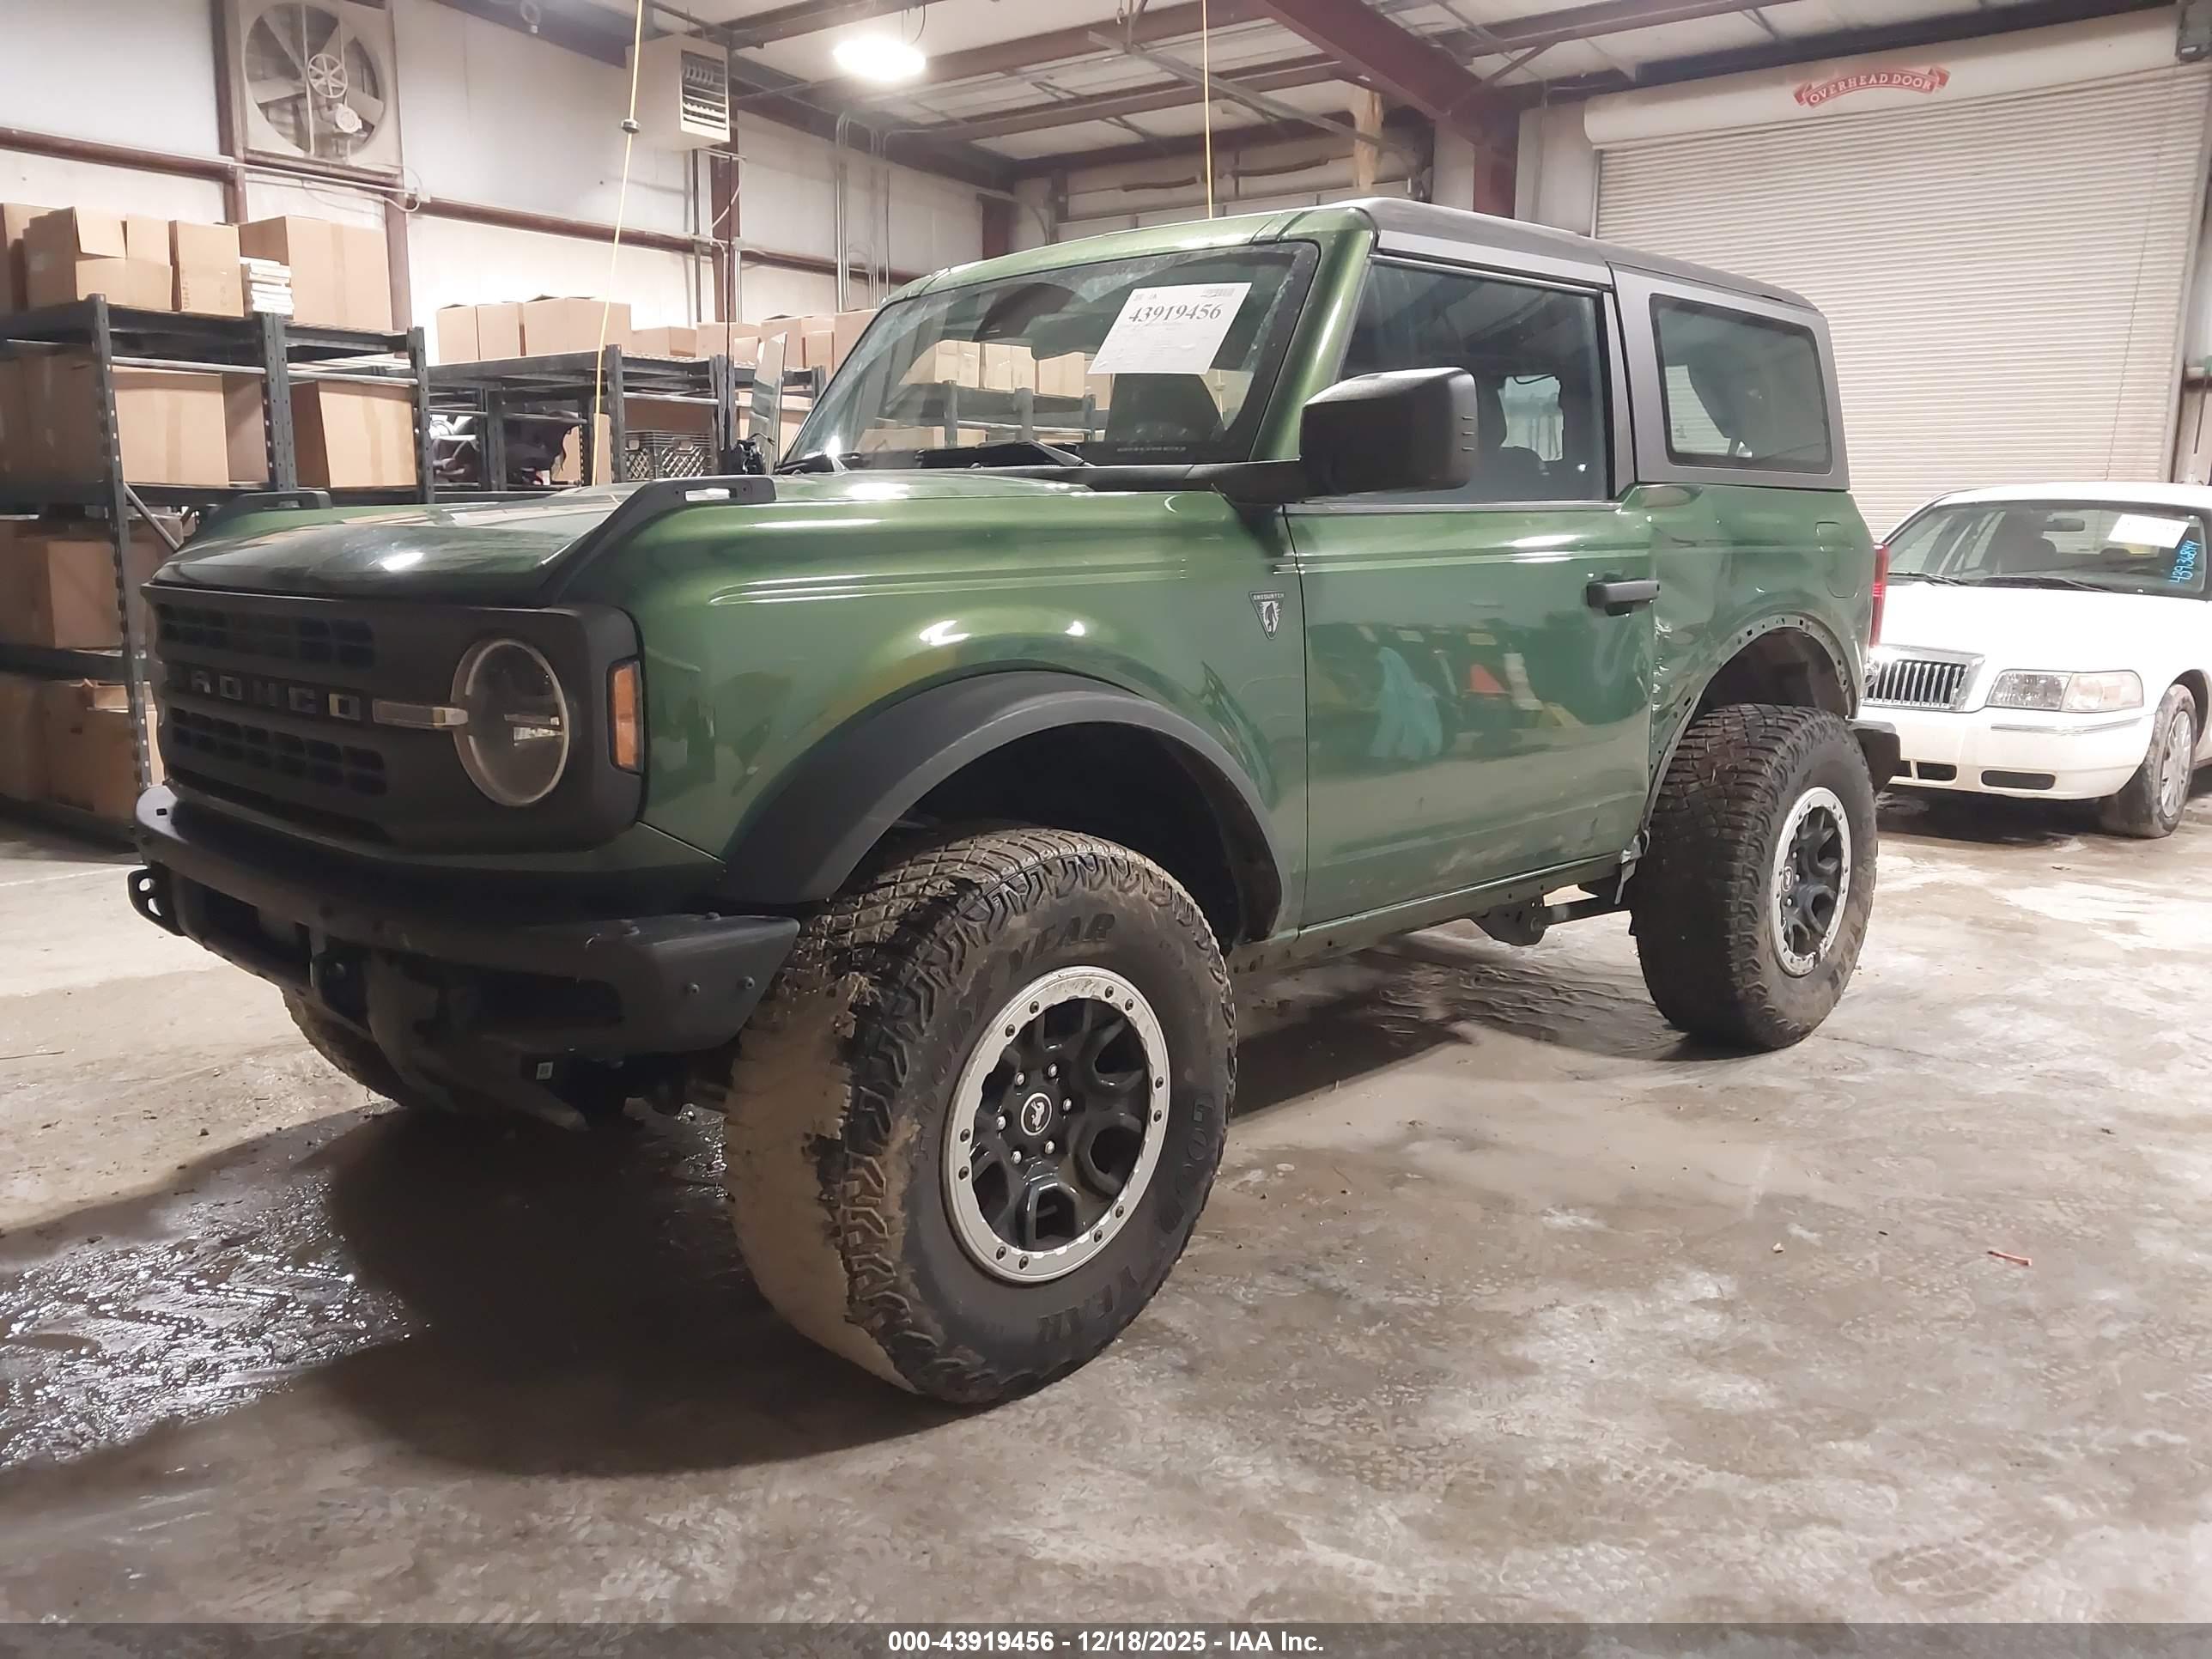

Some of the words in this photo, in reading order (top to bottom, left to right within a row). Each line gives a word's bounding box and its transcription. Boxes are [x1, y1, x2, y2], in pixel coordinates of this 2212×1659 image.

[1809, 73, 1887, 104] OVERHEAD
[1892, 73, 1932, 91] DOOR
[1128, 303, 1224, 323] 43919456
[168, 666, 362, 722] RONCO
